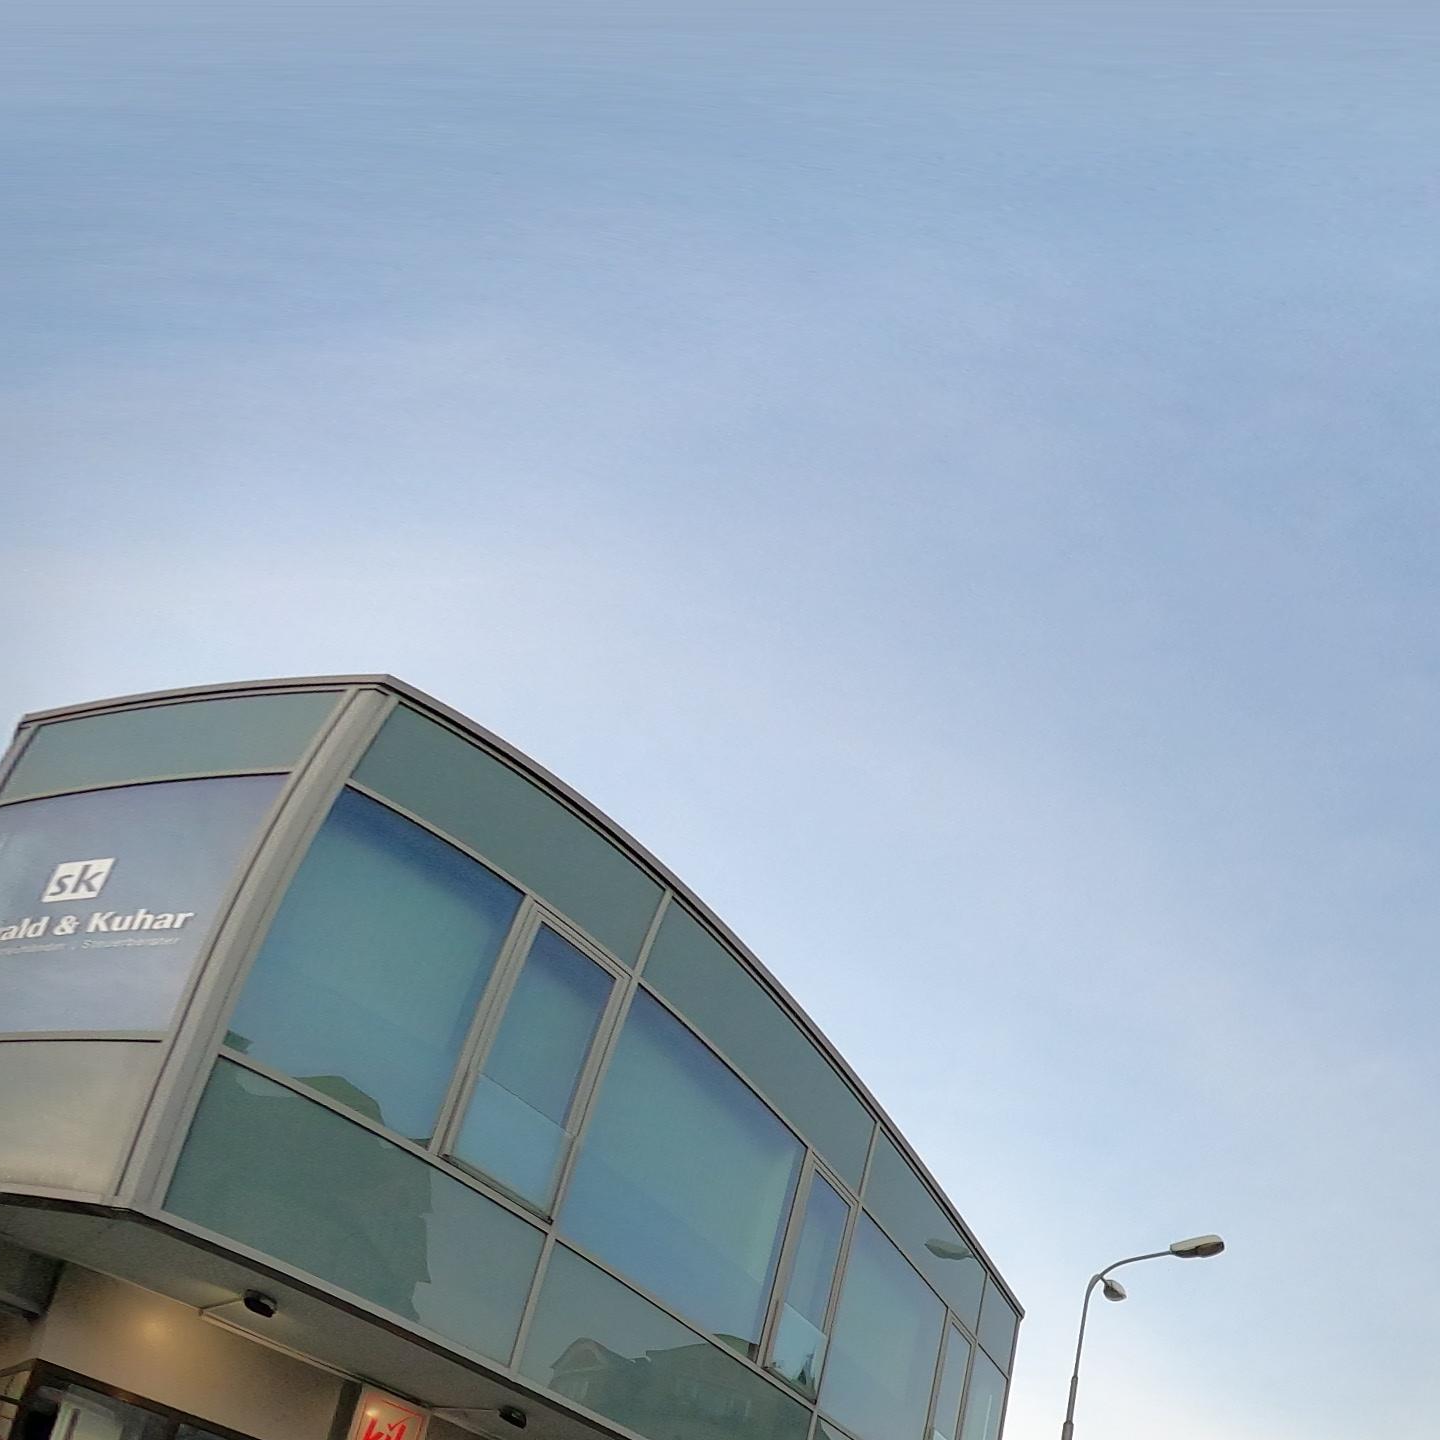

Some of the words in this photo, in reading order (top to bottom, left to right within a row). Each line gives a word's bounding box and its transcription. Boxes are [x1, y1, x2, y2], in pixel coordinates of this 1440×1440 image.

[48, 864, 104, 896] sk
[53, 915, 80, 936] &
[86, 908, 195, 934] Kuhar
